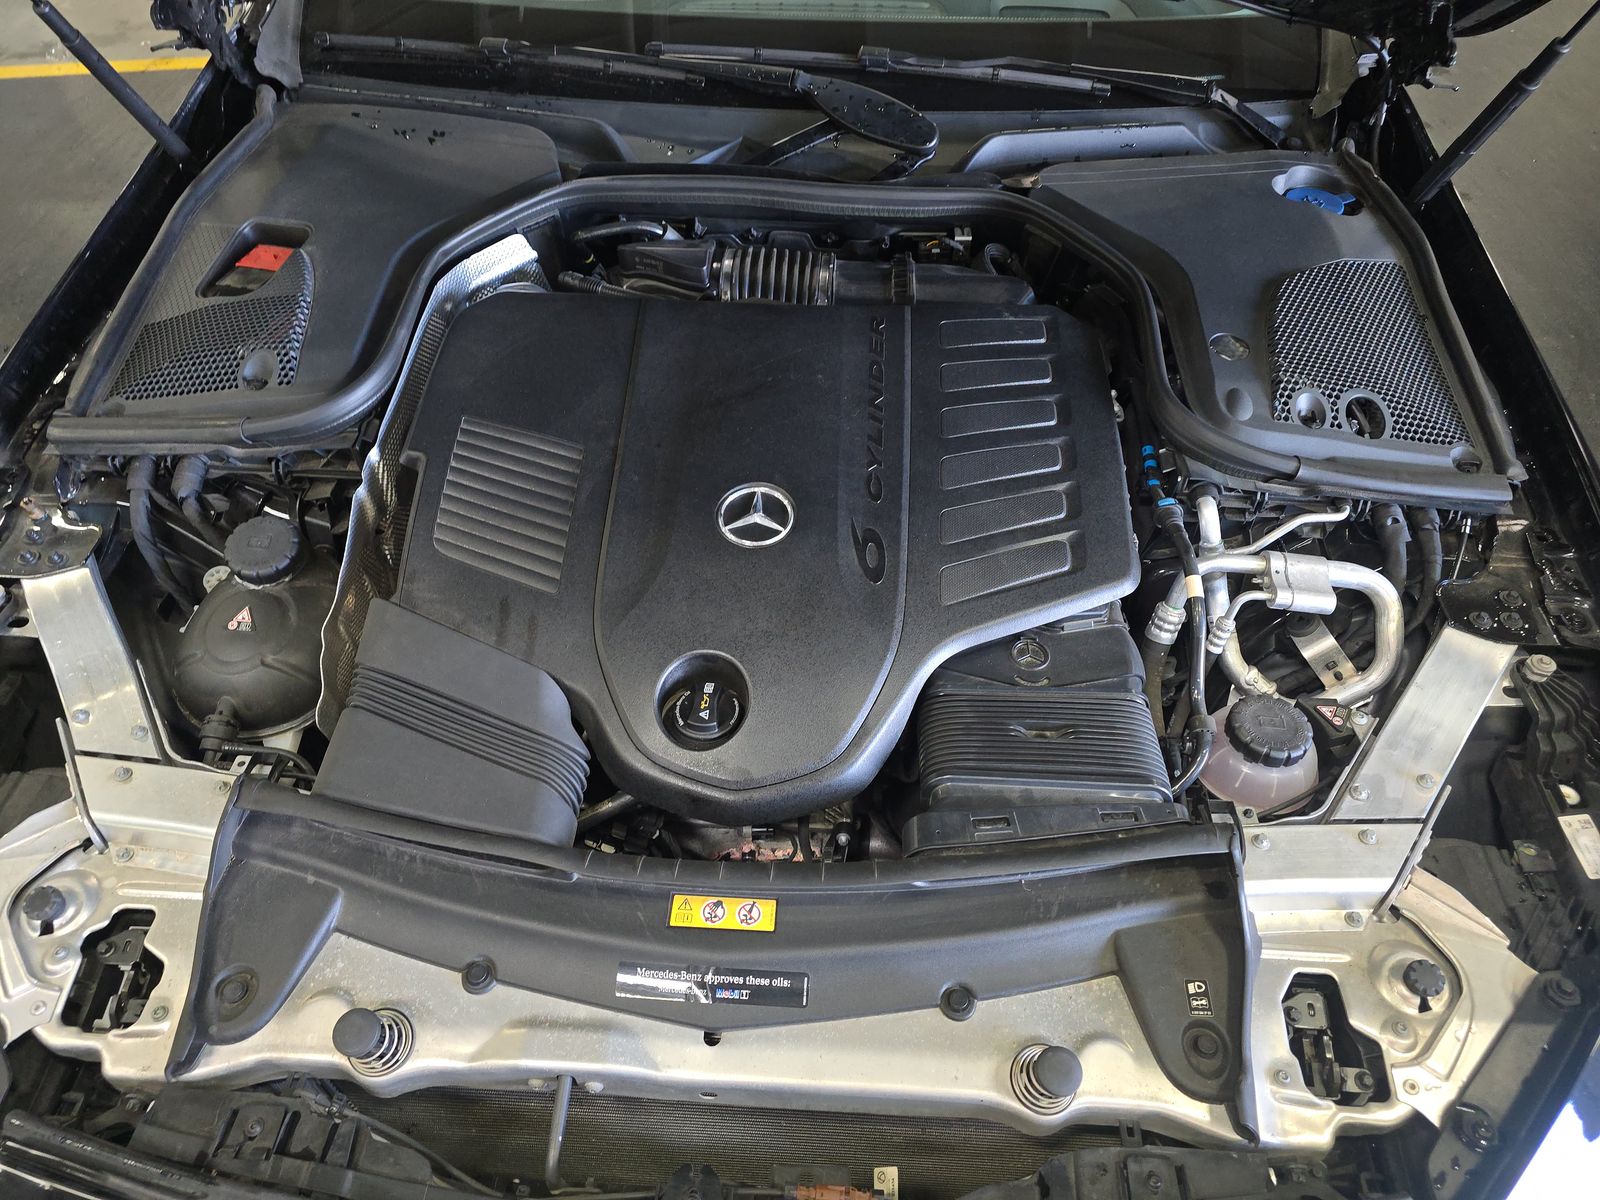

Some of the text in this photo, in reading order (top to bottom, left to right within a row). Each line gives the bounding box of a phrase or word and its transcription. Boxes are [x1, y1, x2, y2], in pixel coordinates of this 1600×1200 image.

[851, 317, 888, 585] 6 CYLINDER
[637, 967, 702, 982] Mercedes-Benz
[704, 973, 743, 985] approves
[746, 975, 770, 986] these
[658, 987, 707, 996] Mercedes-Bnz
[716, 987, 740, 999] Mobil
